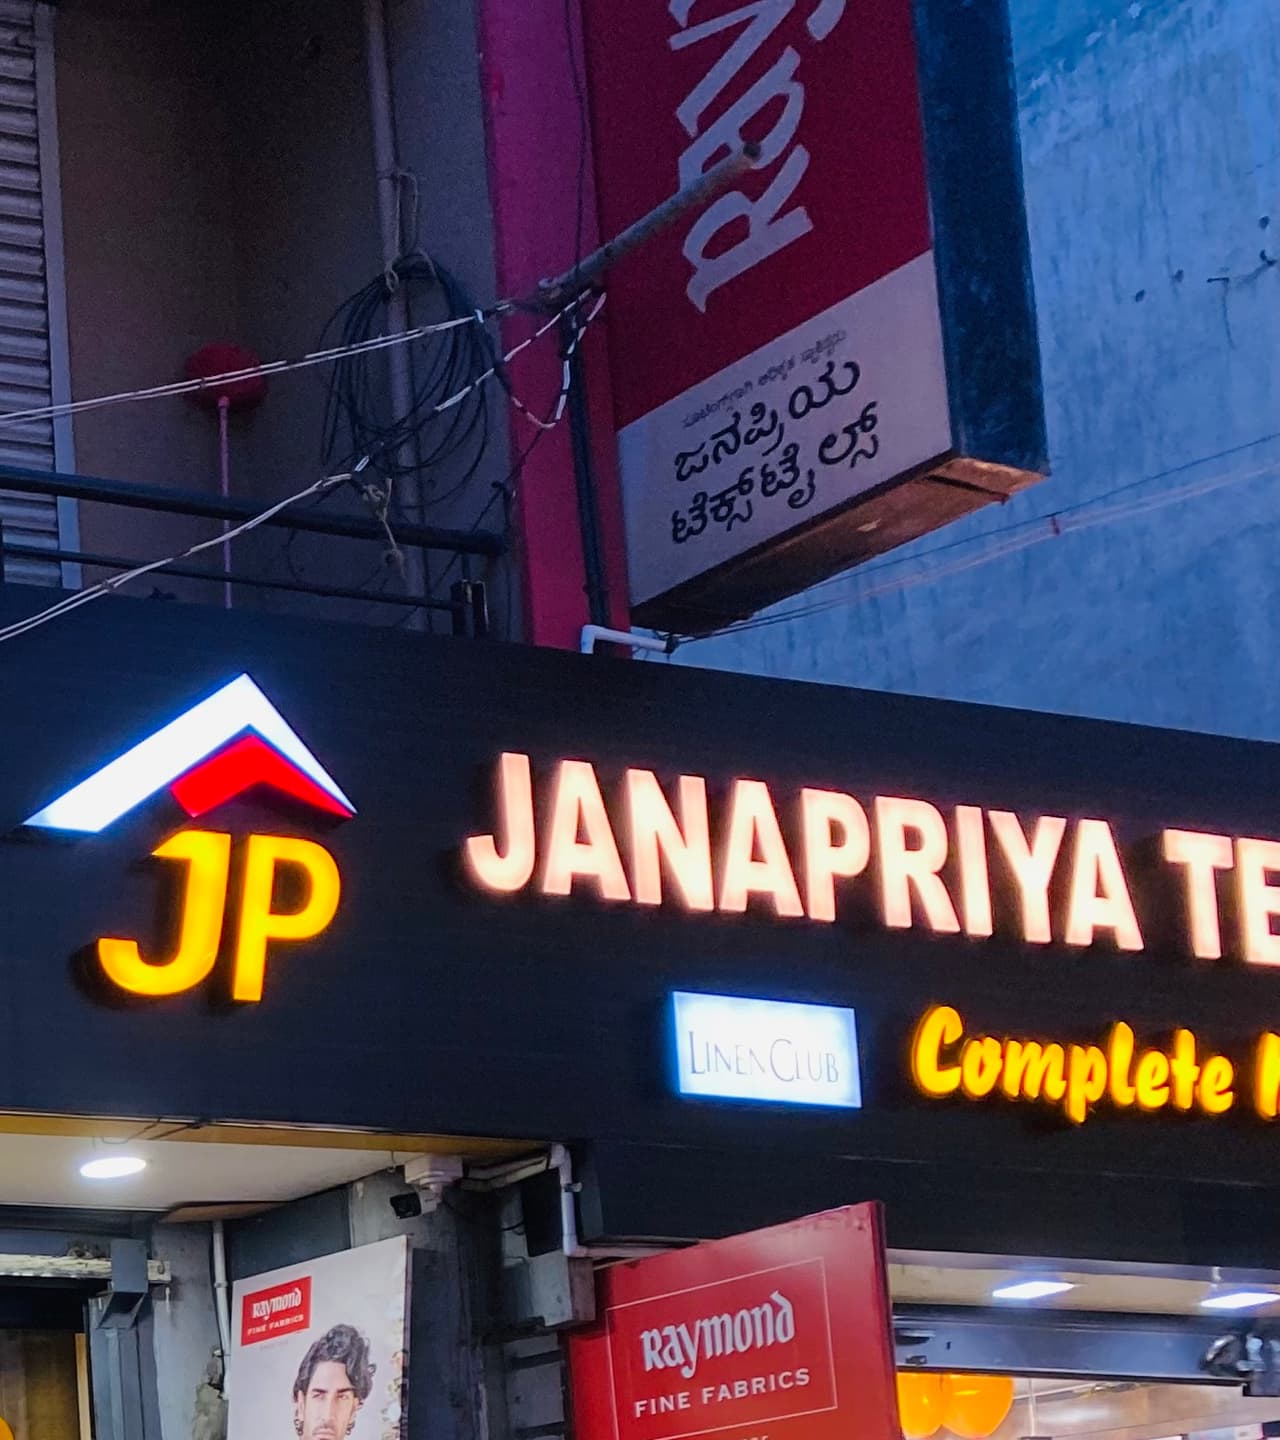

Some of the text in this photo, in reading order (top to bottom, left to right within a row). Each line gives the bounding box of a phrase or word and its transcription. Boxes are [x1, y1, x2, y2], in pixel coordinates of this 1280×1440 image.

[465, 750, 1145, 953] JANAPRIYA
[96, 828, 342, 1002] JP
[910, 1004, 1235, 1123] Complete
[634, 1366, 811, 1418] FINE FABRICS
[640, 1289, 796, 1379] Raymond
